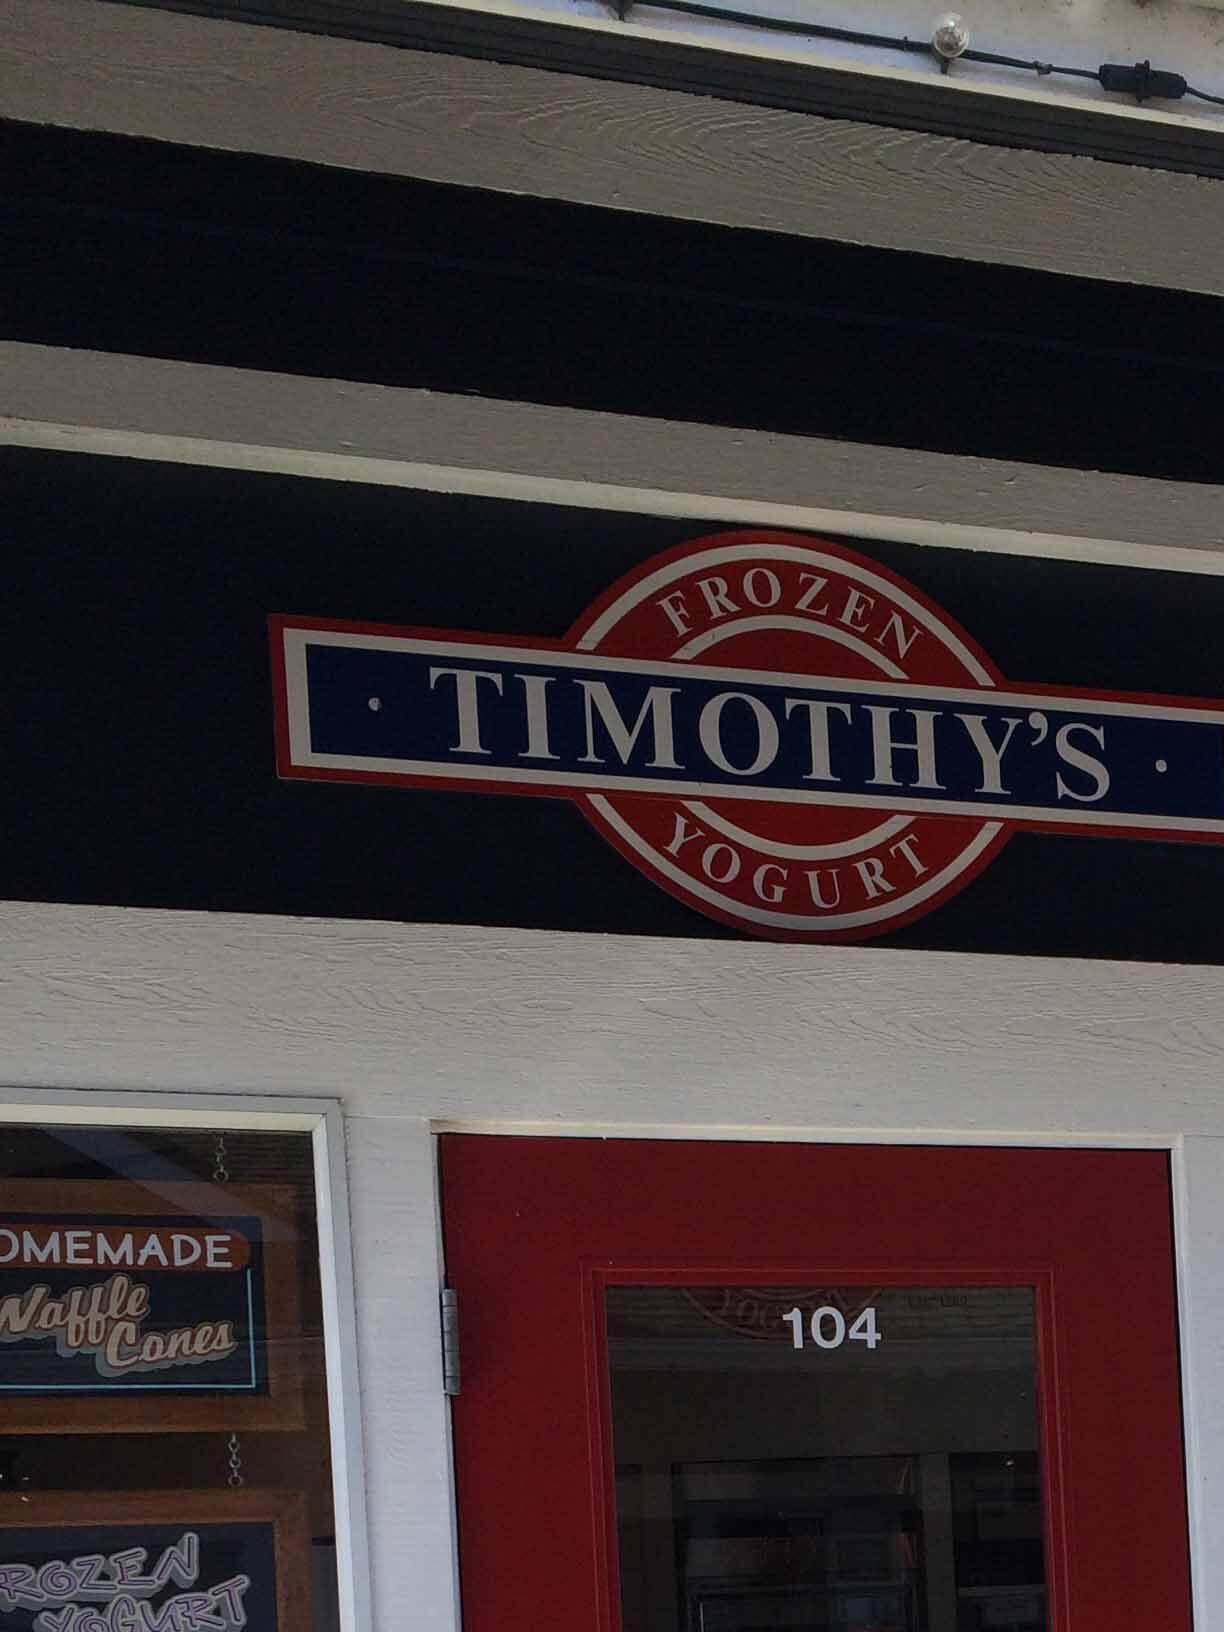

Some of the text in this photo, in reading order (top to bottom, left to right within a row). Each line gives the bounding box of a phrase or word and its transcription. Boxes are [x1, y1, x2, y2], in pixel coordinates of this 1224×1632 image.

[656, 567, 923, 660] FROZEN
[430, 666, 1110, 802] TIMOTHY'S
[663, 812, 929, 908] YOGURT
[106, 1320, 238, 1367] Cones
[782, 1306, 882, 1349] 104
